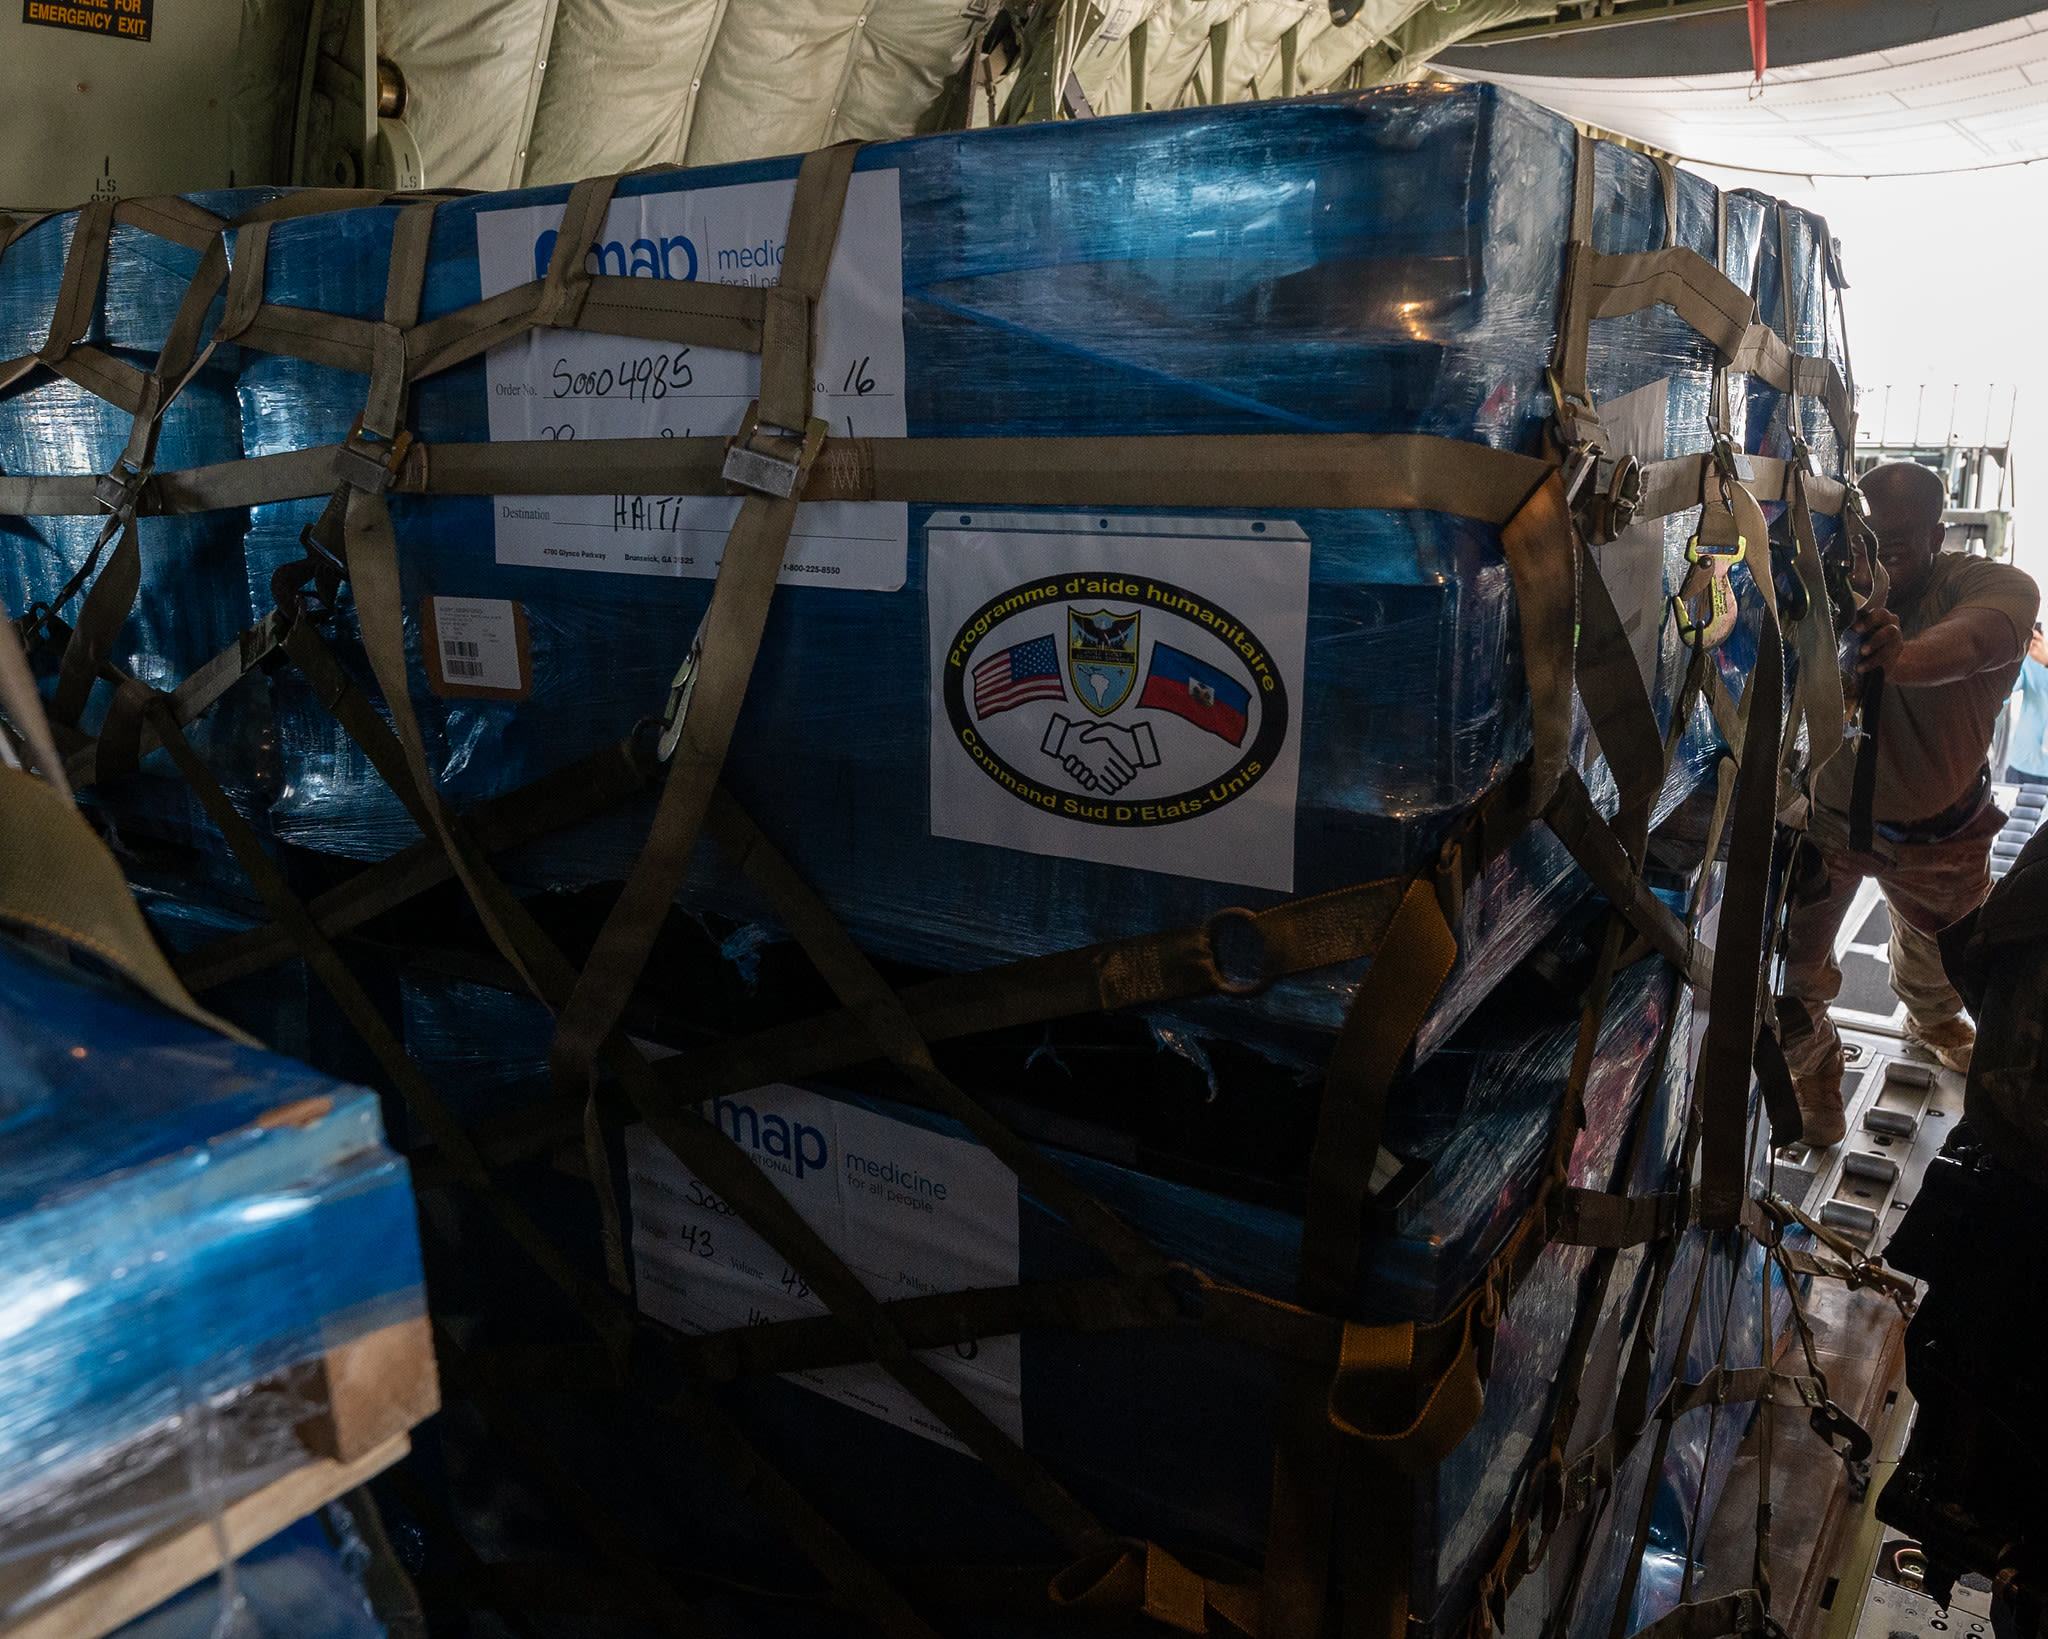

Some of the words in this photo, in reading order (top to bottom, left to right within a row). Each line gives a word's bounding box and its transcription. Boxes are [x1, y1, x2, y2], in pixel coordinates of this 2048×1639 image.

[28, 2, 113, 31] EMERGENCY
[117, 15, 147, 36] EXIT
[495, 382, 522, 397] Order
[842, 355, 876, 398] 16
[502, 504, 551, 521] Destination
[783, 563, 841, 575] 1-800-225-8550
[950, 584, 1059, 668] Programme
[1065, 577, 1140, 597] d'aide
[1146, 584, 1275, 692] humanitaire
[962, 728, 1057, 809] Command
[1063, 799, 1109, 820] Sud
[713, 1097, 828, 1180] map
[846, 1153, 946, 1201] medicine
[847, 1173, 866, 1190] for
[869, 1183, 883, 1198] all
[887, 1190, 933, 1214] people
[682, 1224, 715, 1257] 43
[729, 1257, 765, 1280] Volume
